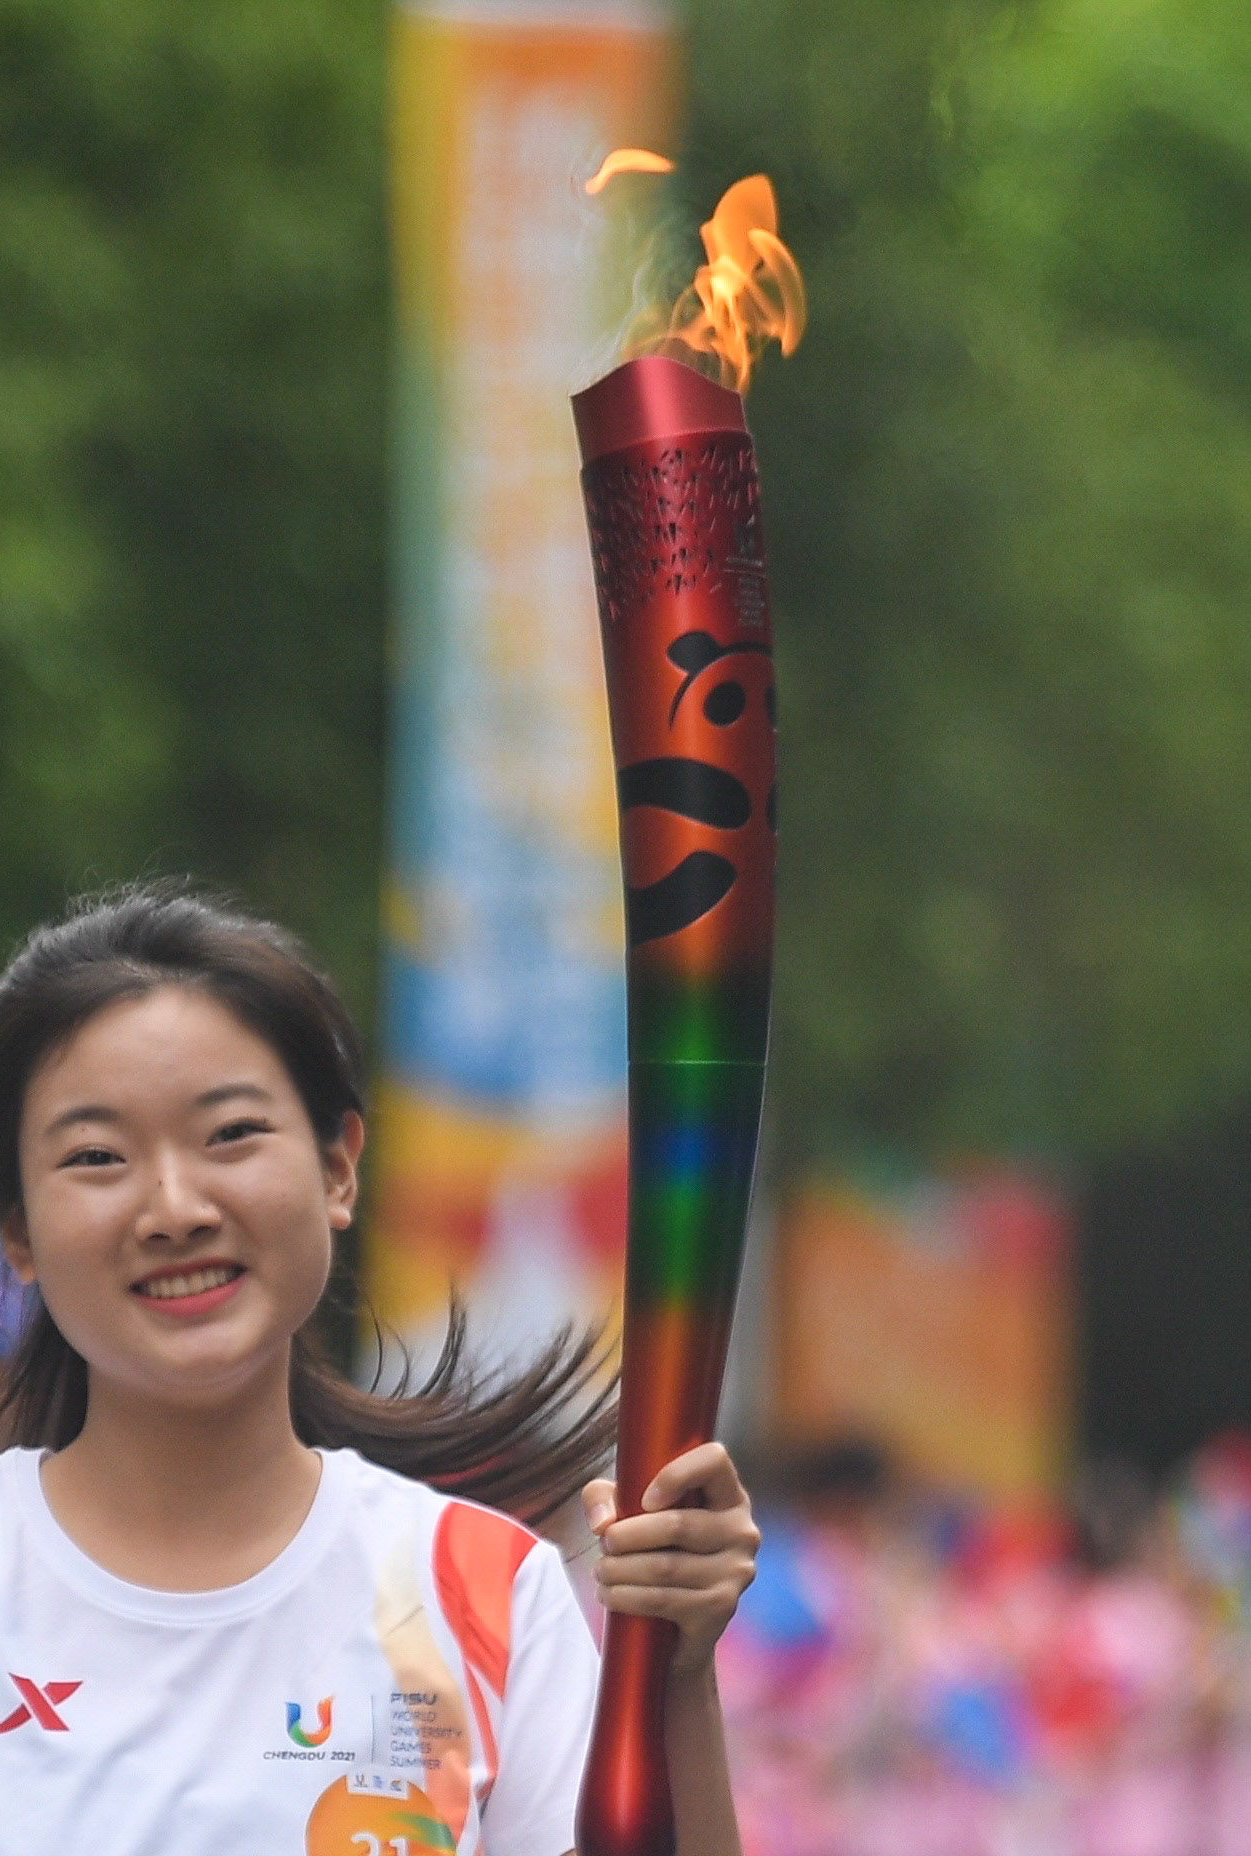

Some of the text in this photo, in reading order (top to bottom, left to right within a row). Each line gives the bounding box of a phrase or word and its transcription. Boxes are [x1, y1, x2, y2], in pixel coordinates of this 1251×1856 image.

[389, 1740, 432, 1754] GAMES
[262, 1750, 356, 1761] CHENGDU 2021
